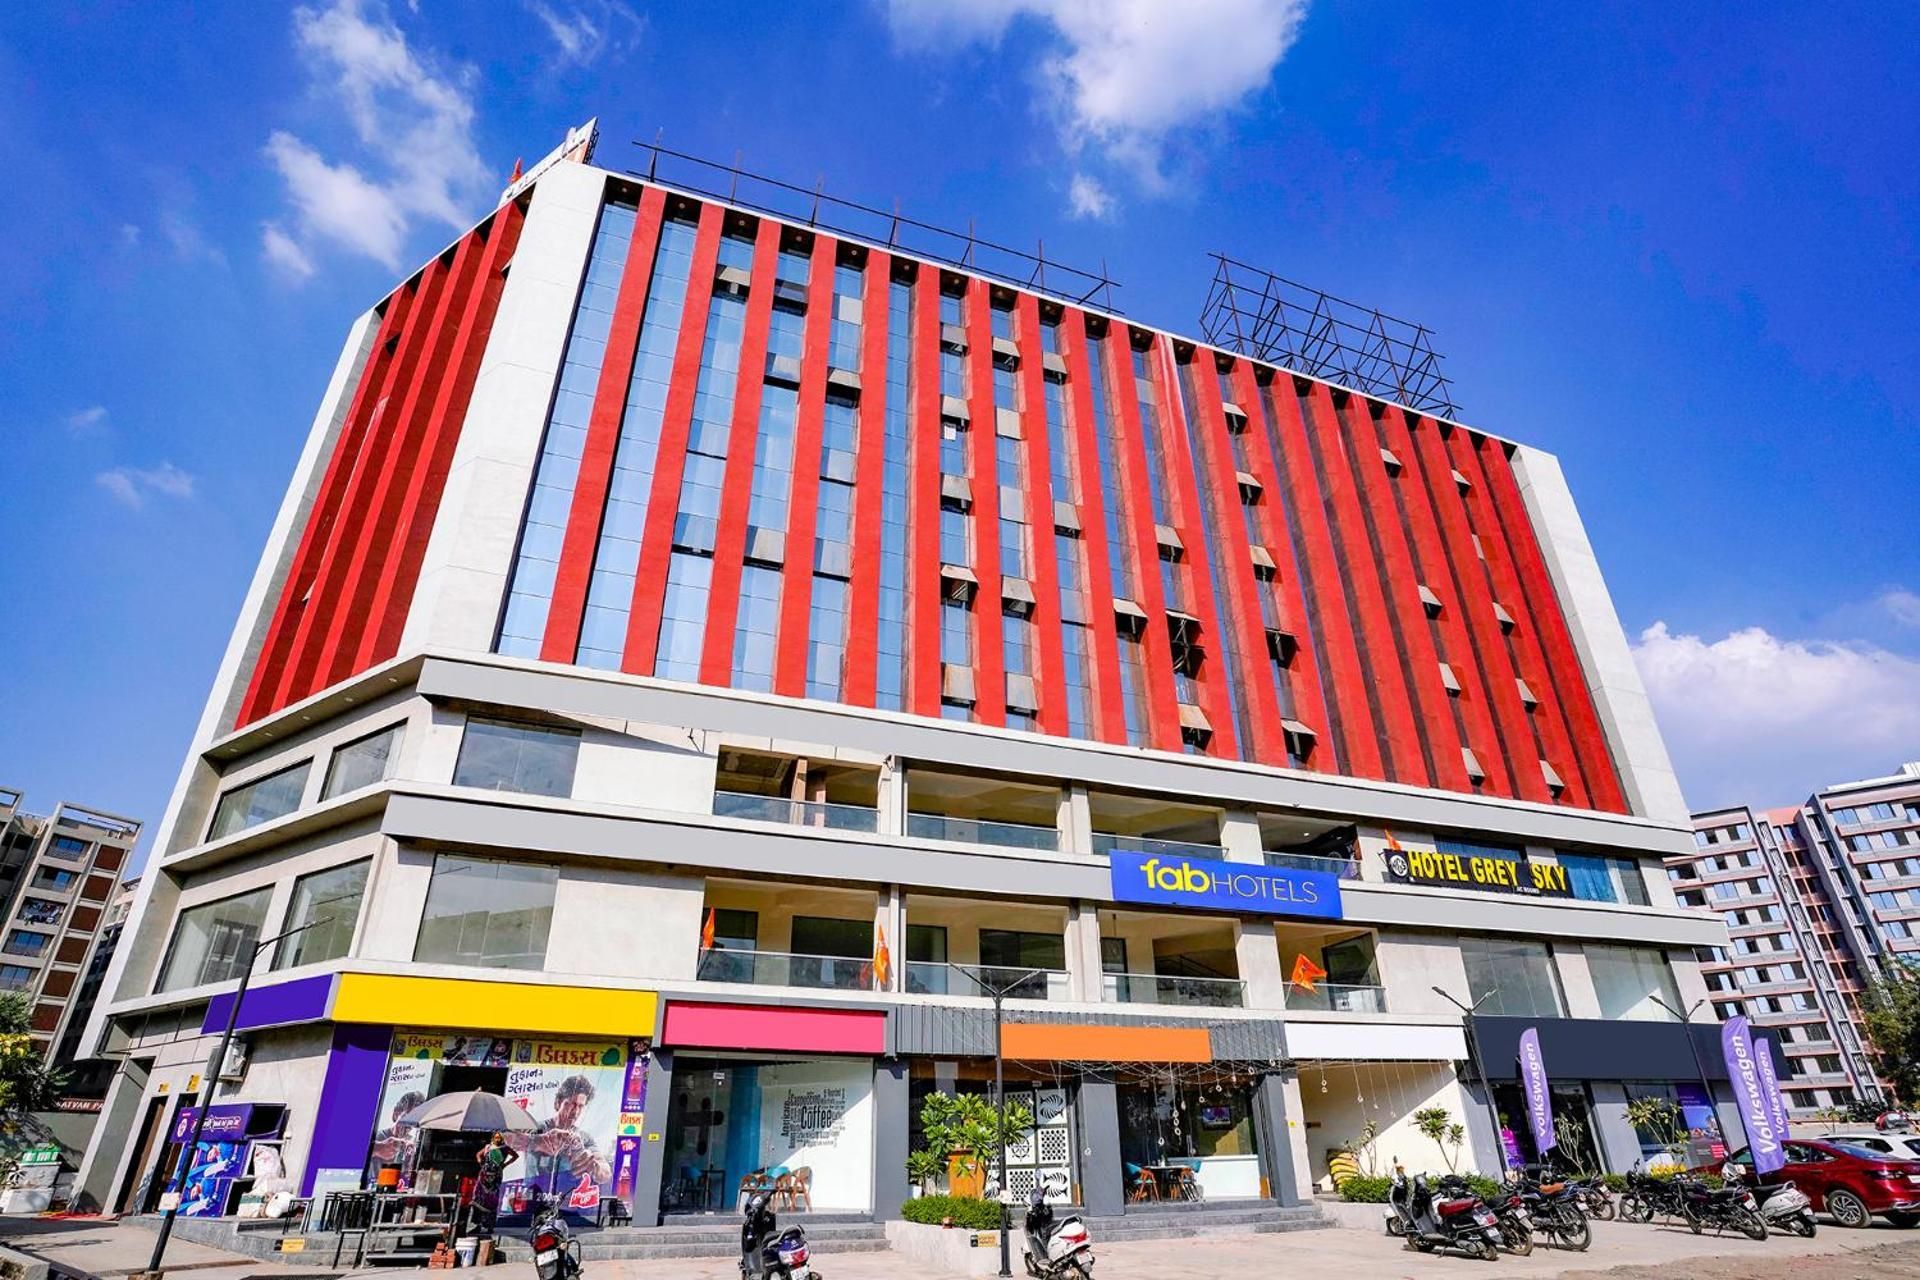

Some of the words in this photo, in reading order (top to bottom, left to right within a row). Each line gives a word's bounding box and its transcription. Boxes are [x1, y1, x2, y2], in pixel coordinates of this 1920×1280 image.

[1408, 850, 1469, 881] HOTEL
[1471, 857, 1518, 886] GREY
[1531, 864, 1567, 891] SKY
[801, 1105, 832, 1130] Coffee
[1526, 1043, 1546, 1137] Volkswagen
[1732, 1036, 1778, 1154] Volkswagen
[1760, 1051, 1785, 1135] Volkswagen
